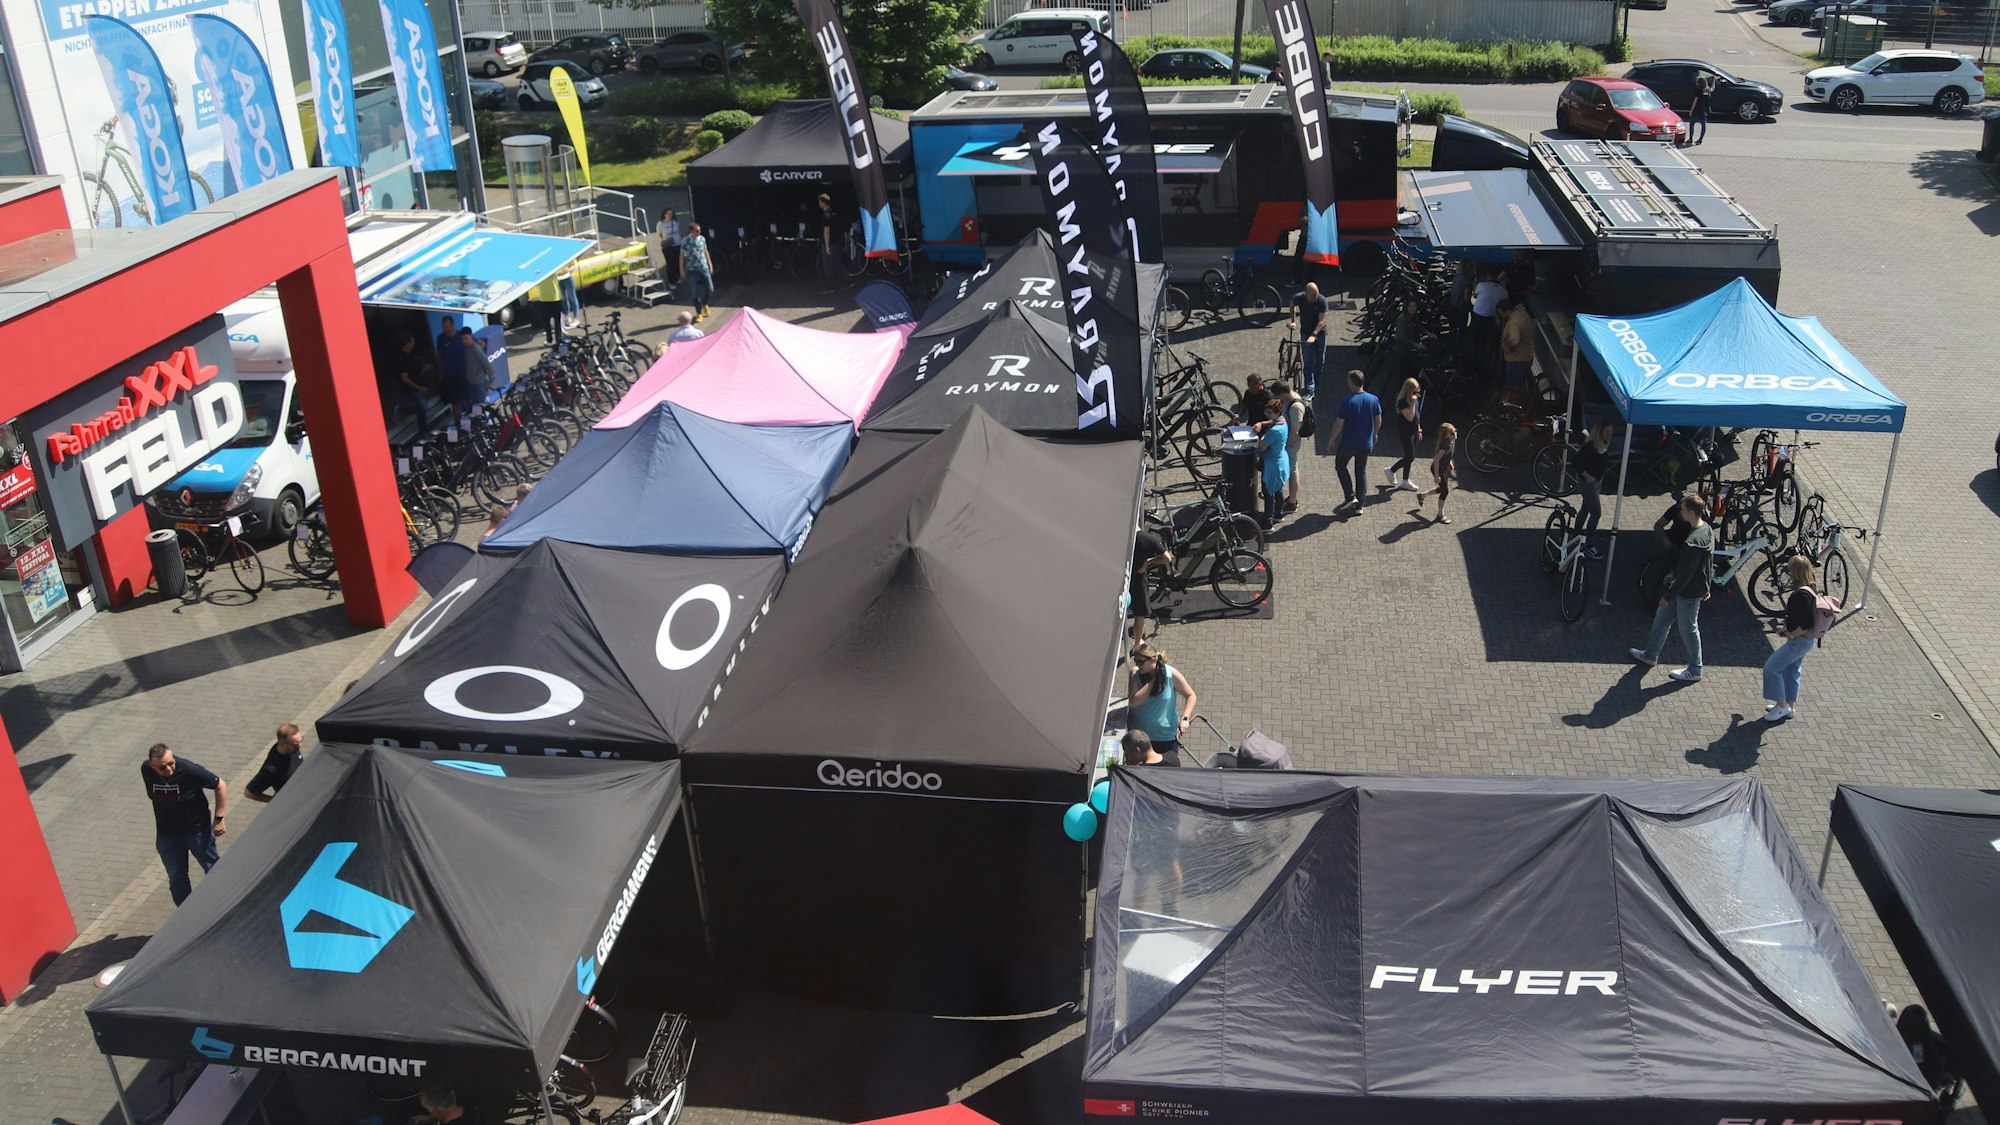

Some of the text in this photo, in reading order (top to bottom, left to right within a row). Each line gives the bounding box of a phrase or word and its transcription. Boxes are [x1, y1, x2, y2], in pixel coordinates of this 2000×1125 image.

[773, 170, 823, 180] CARVER
[488, 347, 506, 363] OGA
[1608, 320, 1662, 377] ORBEA
[945, 381, 1060, 395] RAYMON
[1606, 375, 1627, 409] ORBEA
[1666, 373, 1850, 392] ORBEA
[1806, 412, 1893, 425] ORBEA
[82, 381, 244, 520] FELD
[816, 760, 942, 790] Qeridoo
[597, 834, 658, 967] BERGAMONT
[1369, 965, 1620, 996] FLYER
[244, 1045, 427, 1078] BERGAMONT
[1174, 1108, 1209, 1116] PIONIER
